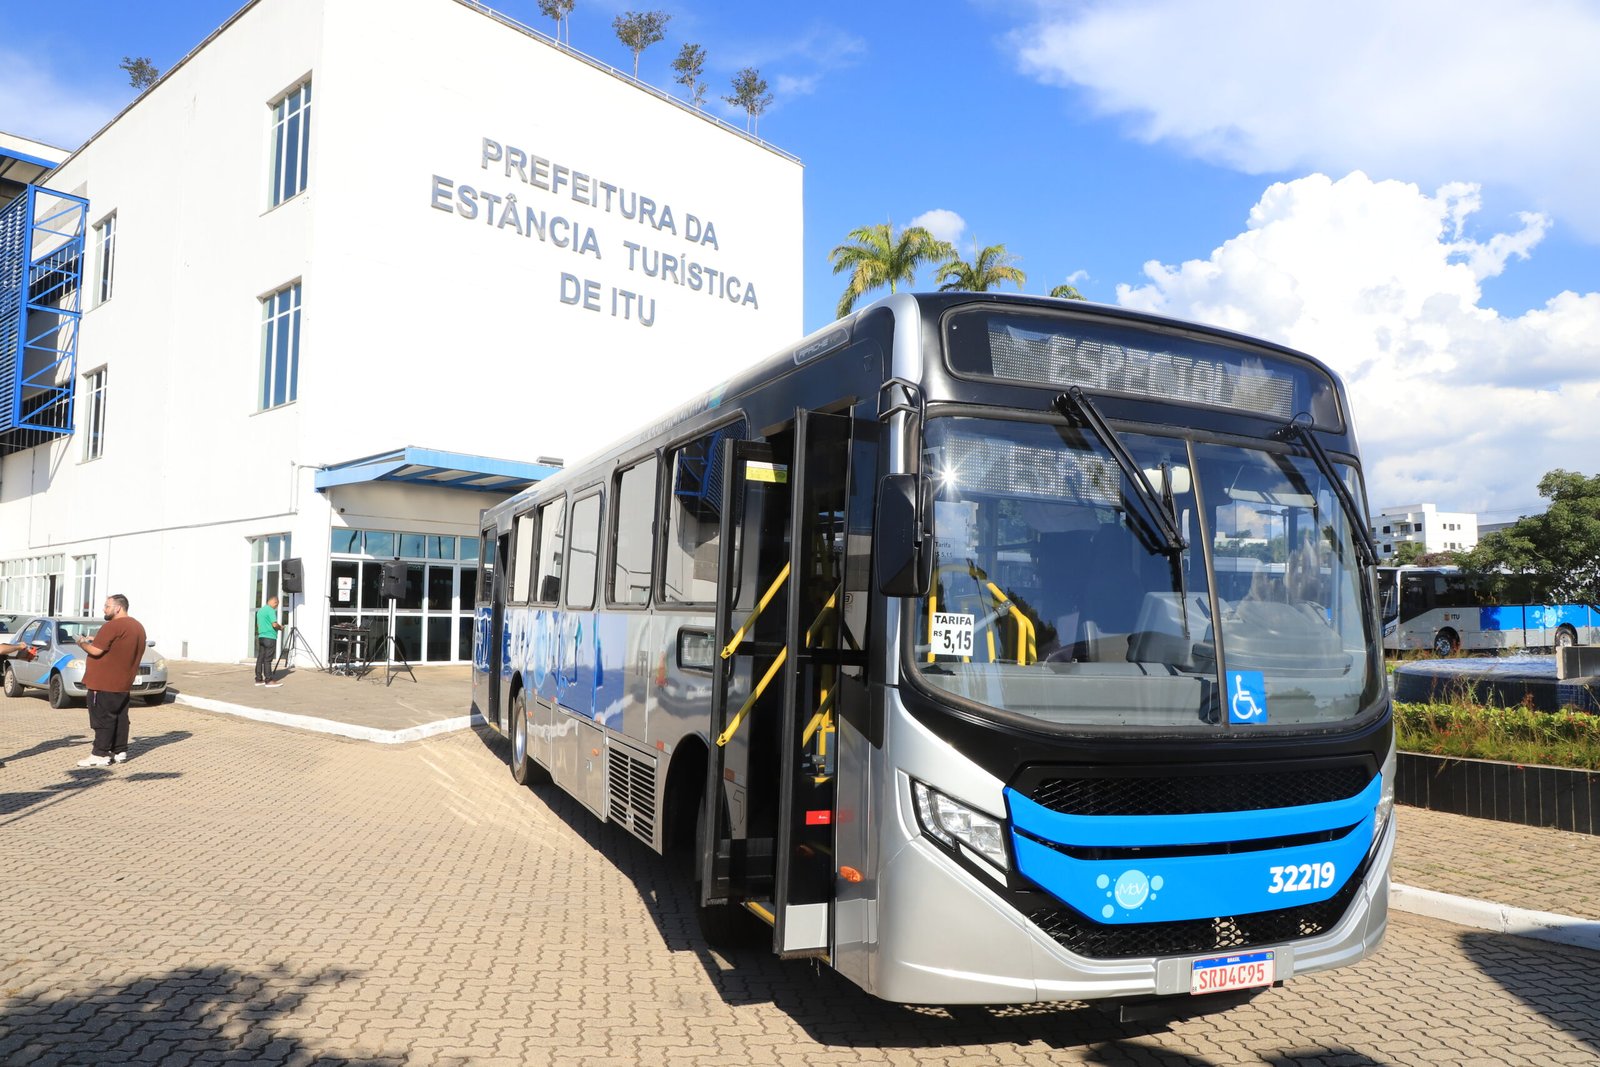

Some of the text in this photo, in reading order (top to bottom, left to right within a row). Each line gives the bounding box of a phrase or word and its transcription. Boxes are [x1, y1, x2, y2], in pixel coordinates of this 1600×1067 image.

[481, 137, 719, 250] PREFEITURA DA
[430, 174, 759, 309] ESTÂNCIA TURÍSTICA
[560, 272, 656, 327] DE ITU
[934, 615, 972, 625] TARIFA
[943, 629, 972, 653] 5,15
[1267, 861, 1336, 894] 32219
[1199, 963, 1265, 990] SRD4C95
